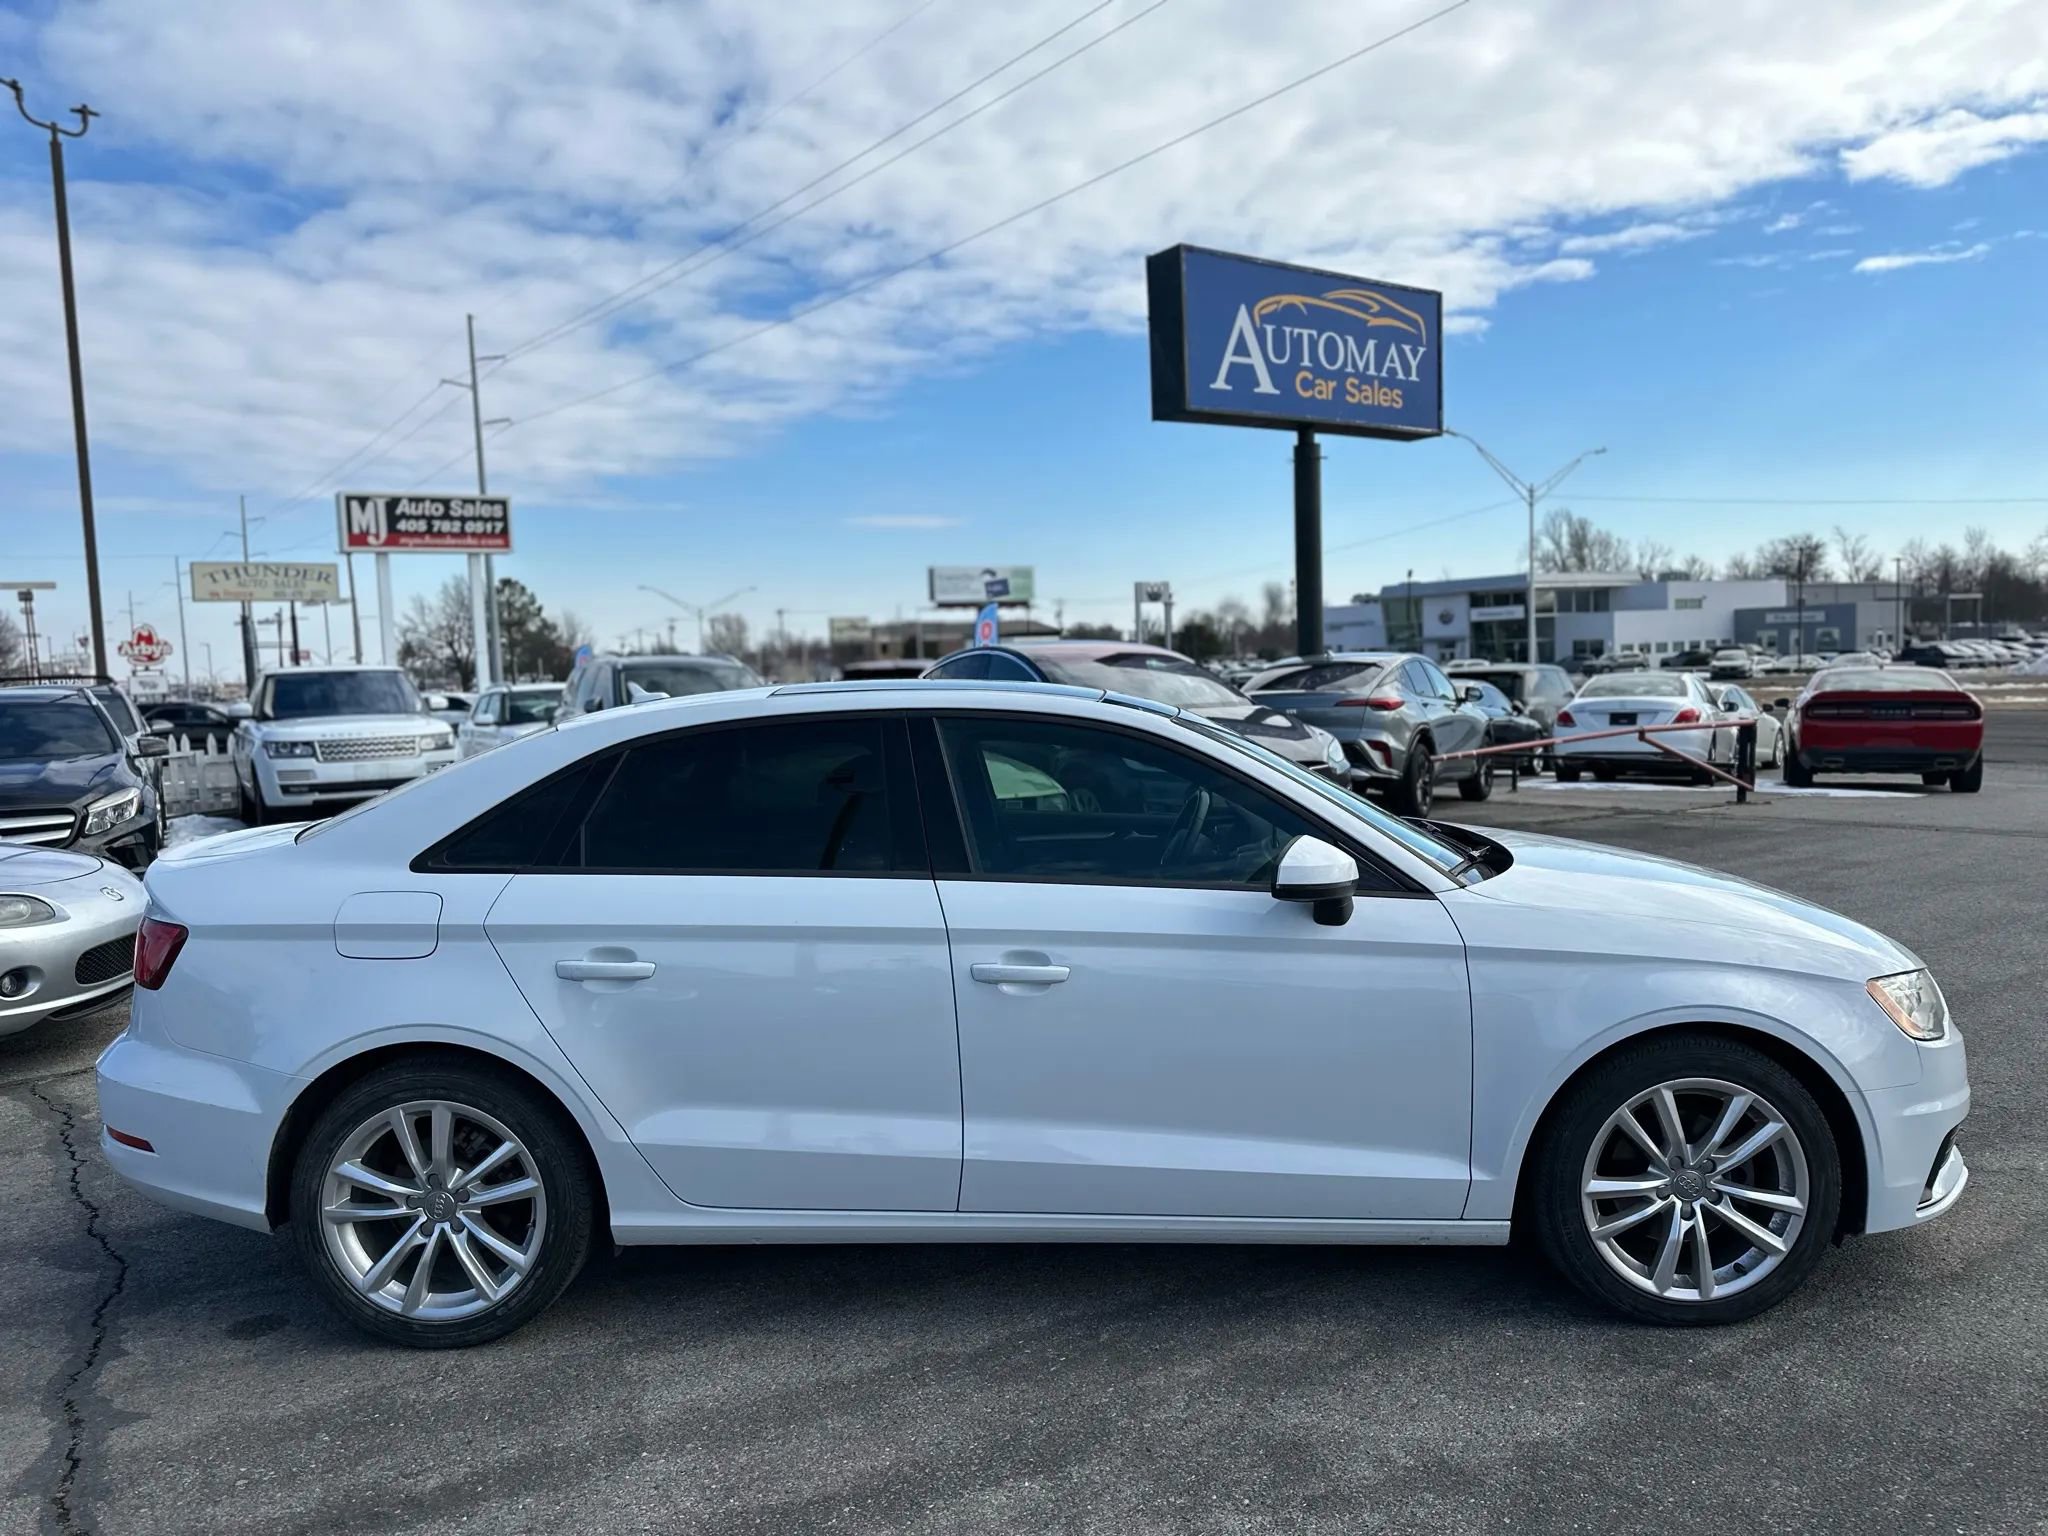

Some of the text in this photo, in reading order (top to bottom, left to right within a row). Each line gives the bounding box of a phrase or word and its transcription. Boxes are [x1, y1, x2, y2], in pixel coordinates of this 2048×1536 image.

[1209, 303, 1426, 394] AUTOMAY
[1295, 371, 1403, 408] Car Sales
[395, 498, 504, 518] Auto Sales
[350, 497, 390, 546] MJ
[396, 518, 428, 532] 405
[203, 564, 333, 584] THUNDER
[237, 577, 306, 588] AUTO SALES
